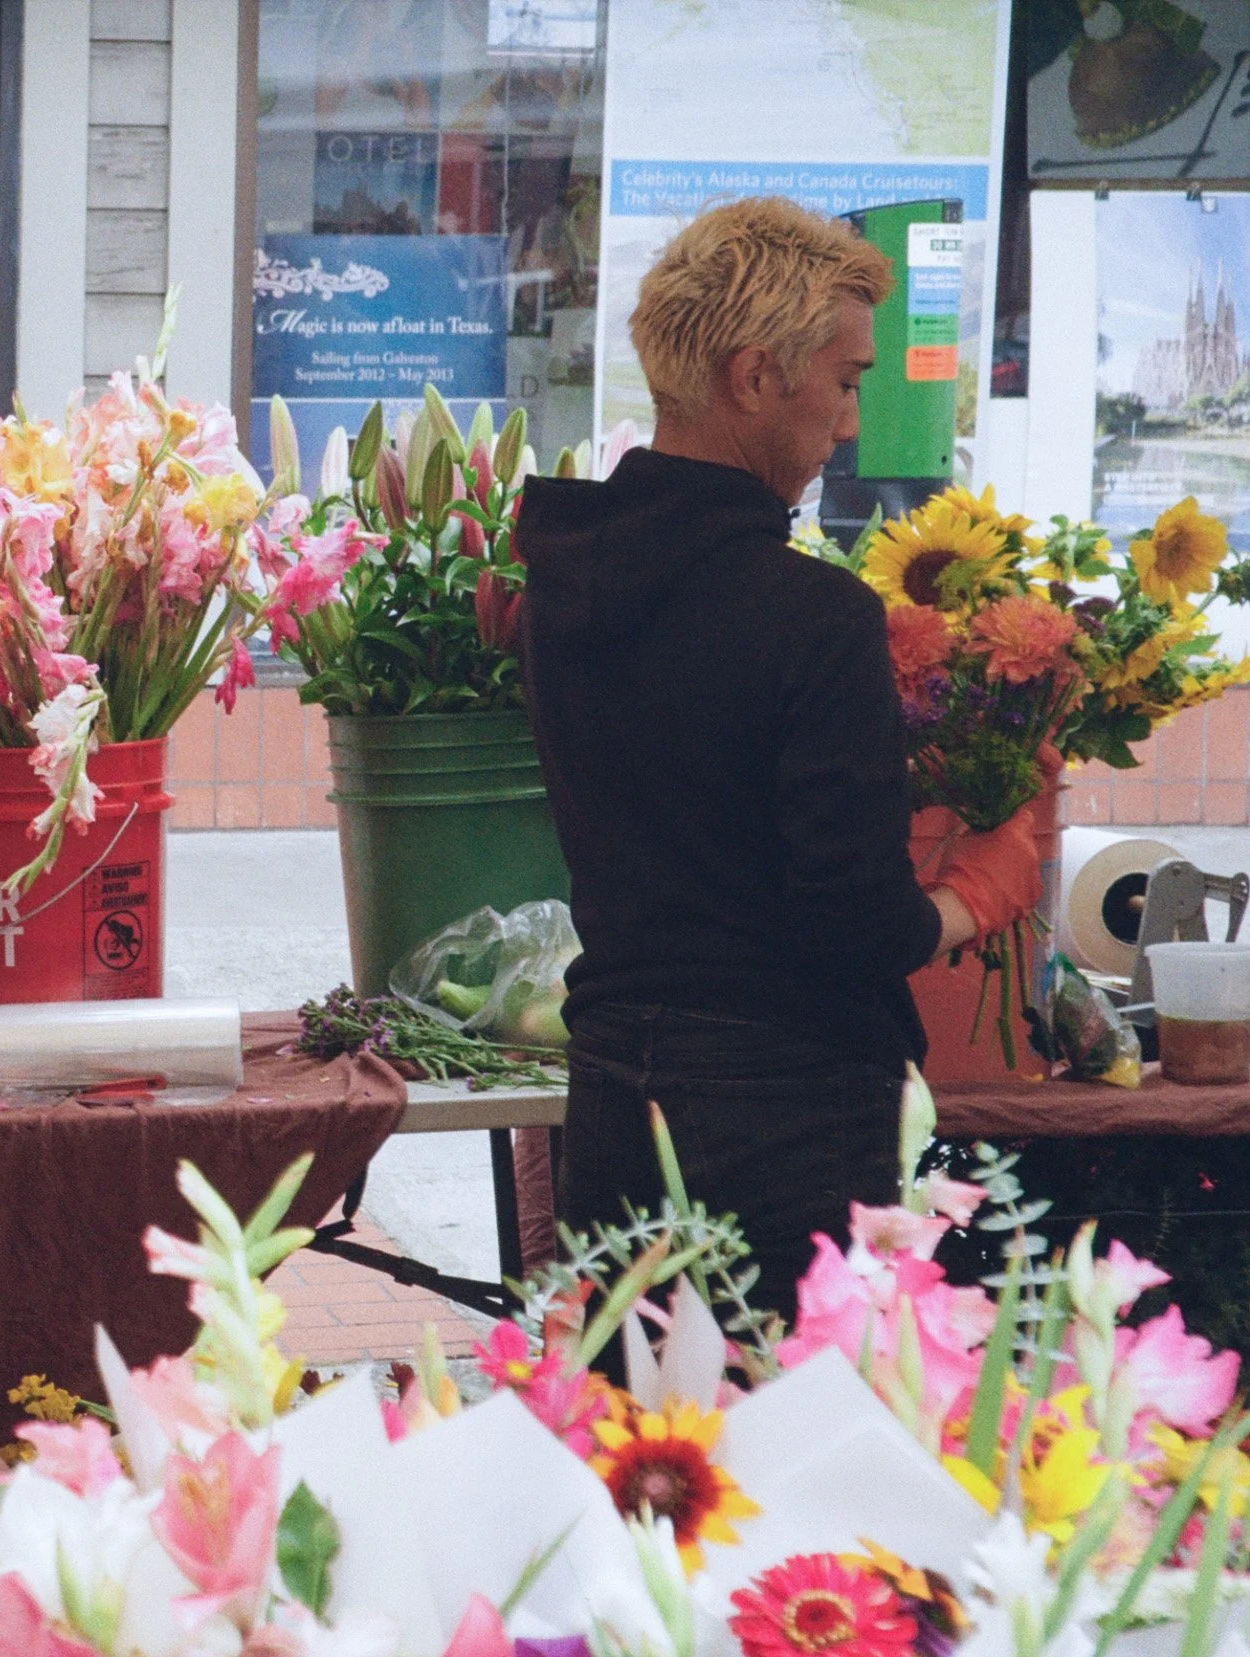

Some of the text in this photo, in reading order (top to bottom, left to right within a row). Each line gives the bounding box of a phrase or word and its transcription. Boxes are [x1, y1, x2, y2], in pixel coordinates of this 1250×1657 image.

[621, 169, 702, 189] Celebrity's
[708, 171, 760, 187] Alaska
[764, 172, 794, 188] and
[798, 173, 857, 189] Canada
[622, 190, 651, 207] The
[833, 192, 850, 212] by
[257, 308, 495, 338] Magic is now afloat in Texas.
[311, 351, 439, 367] Sailing from Galveston
[295, 367, 355, 384] September
[357, 368, 386, 382] 2012
[398, 368, 424, 385] May
[428, 369, 454, 383] 2013
